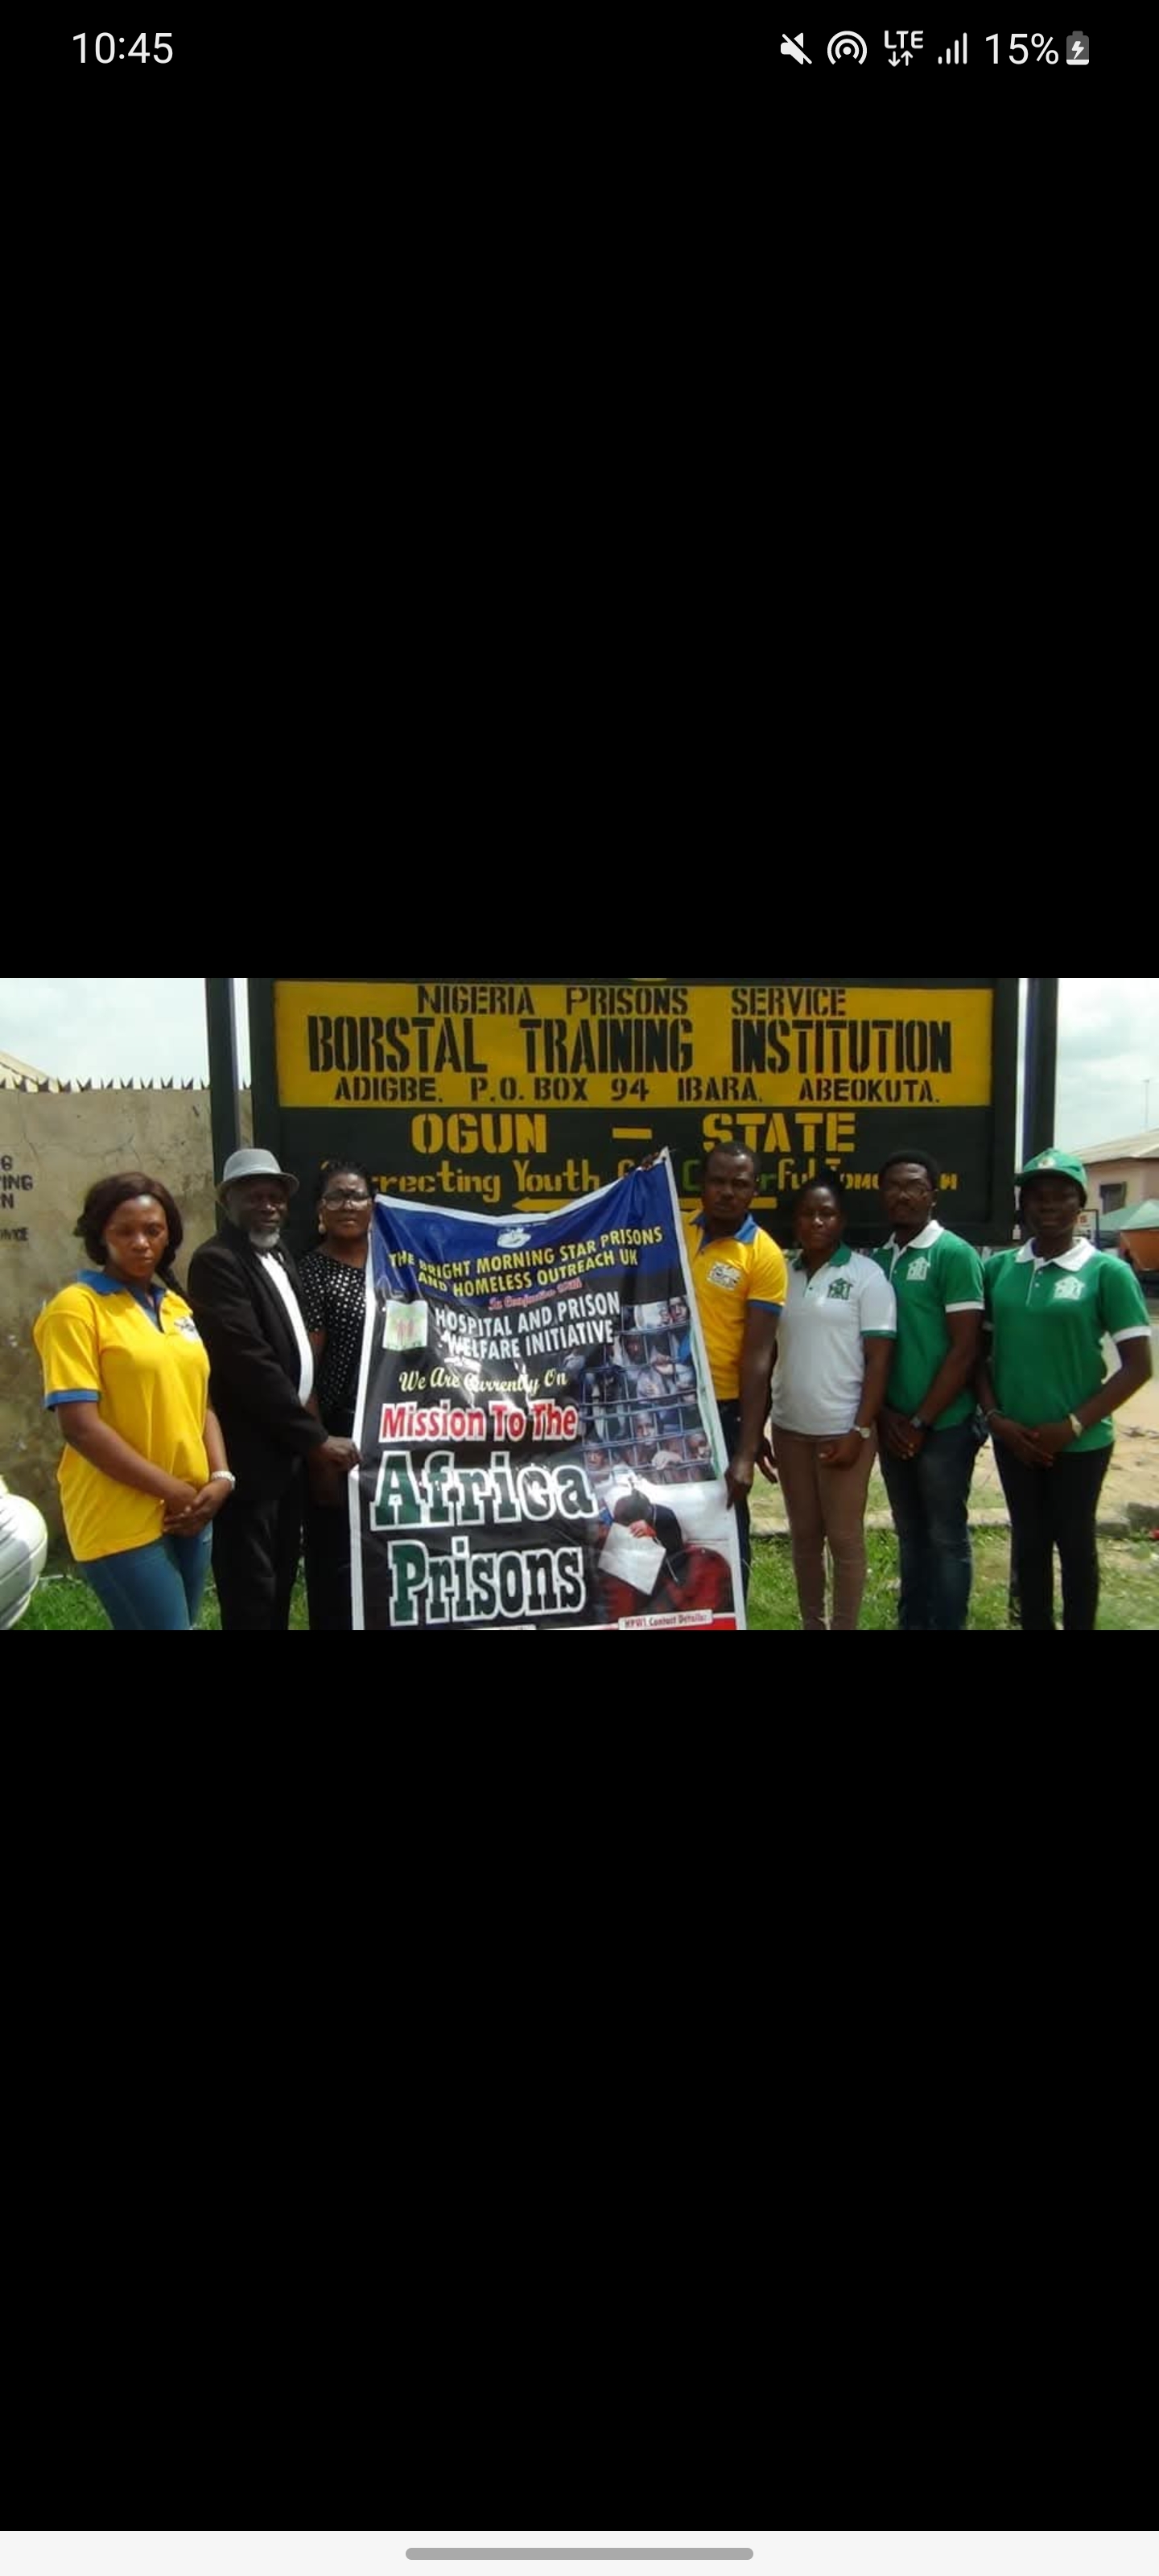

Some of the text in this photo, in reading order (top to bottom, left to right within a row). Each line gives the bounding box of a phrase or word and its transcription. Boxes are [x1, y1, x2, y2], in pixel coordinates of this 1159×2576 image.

[417, 986, 846, 1017] NIGERIA PRISONS SERVICE
[307, 1015, 952, 1074] BORSTAL TRAINING INSTITUTION
[534, 1077, 588, 1101] BOX
[611, 1077, 650, 1102] 94
[411, 1113, 547, 1154] OGUN
[703, 1113, 856, 1153] STATE
[513, 1159, 600, 1192] Youth
[388, 1226, 662, 1280] THE BRIGHT MORNING STAR PRISONS
[418, 1249, 637, 1298] AND HOMELESS OUTREACH UK
[435, 1291, 620, 1336] HOSPITAL AND PRISON
[447, 1319, 613, 1360] WELFARE INITIATIVE
[398, 1367, 567, 1396] We Are Currently On
[379, 1399, 579, 1443] Mission To The
[370, 1451, 599, 1530] Africa
[387, 1536, 587, 1626] Prisons
